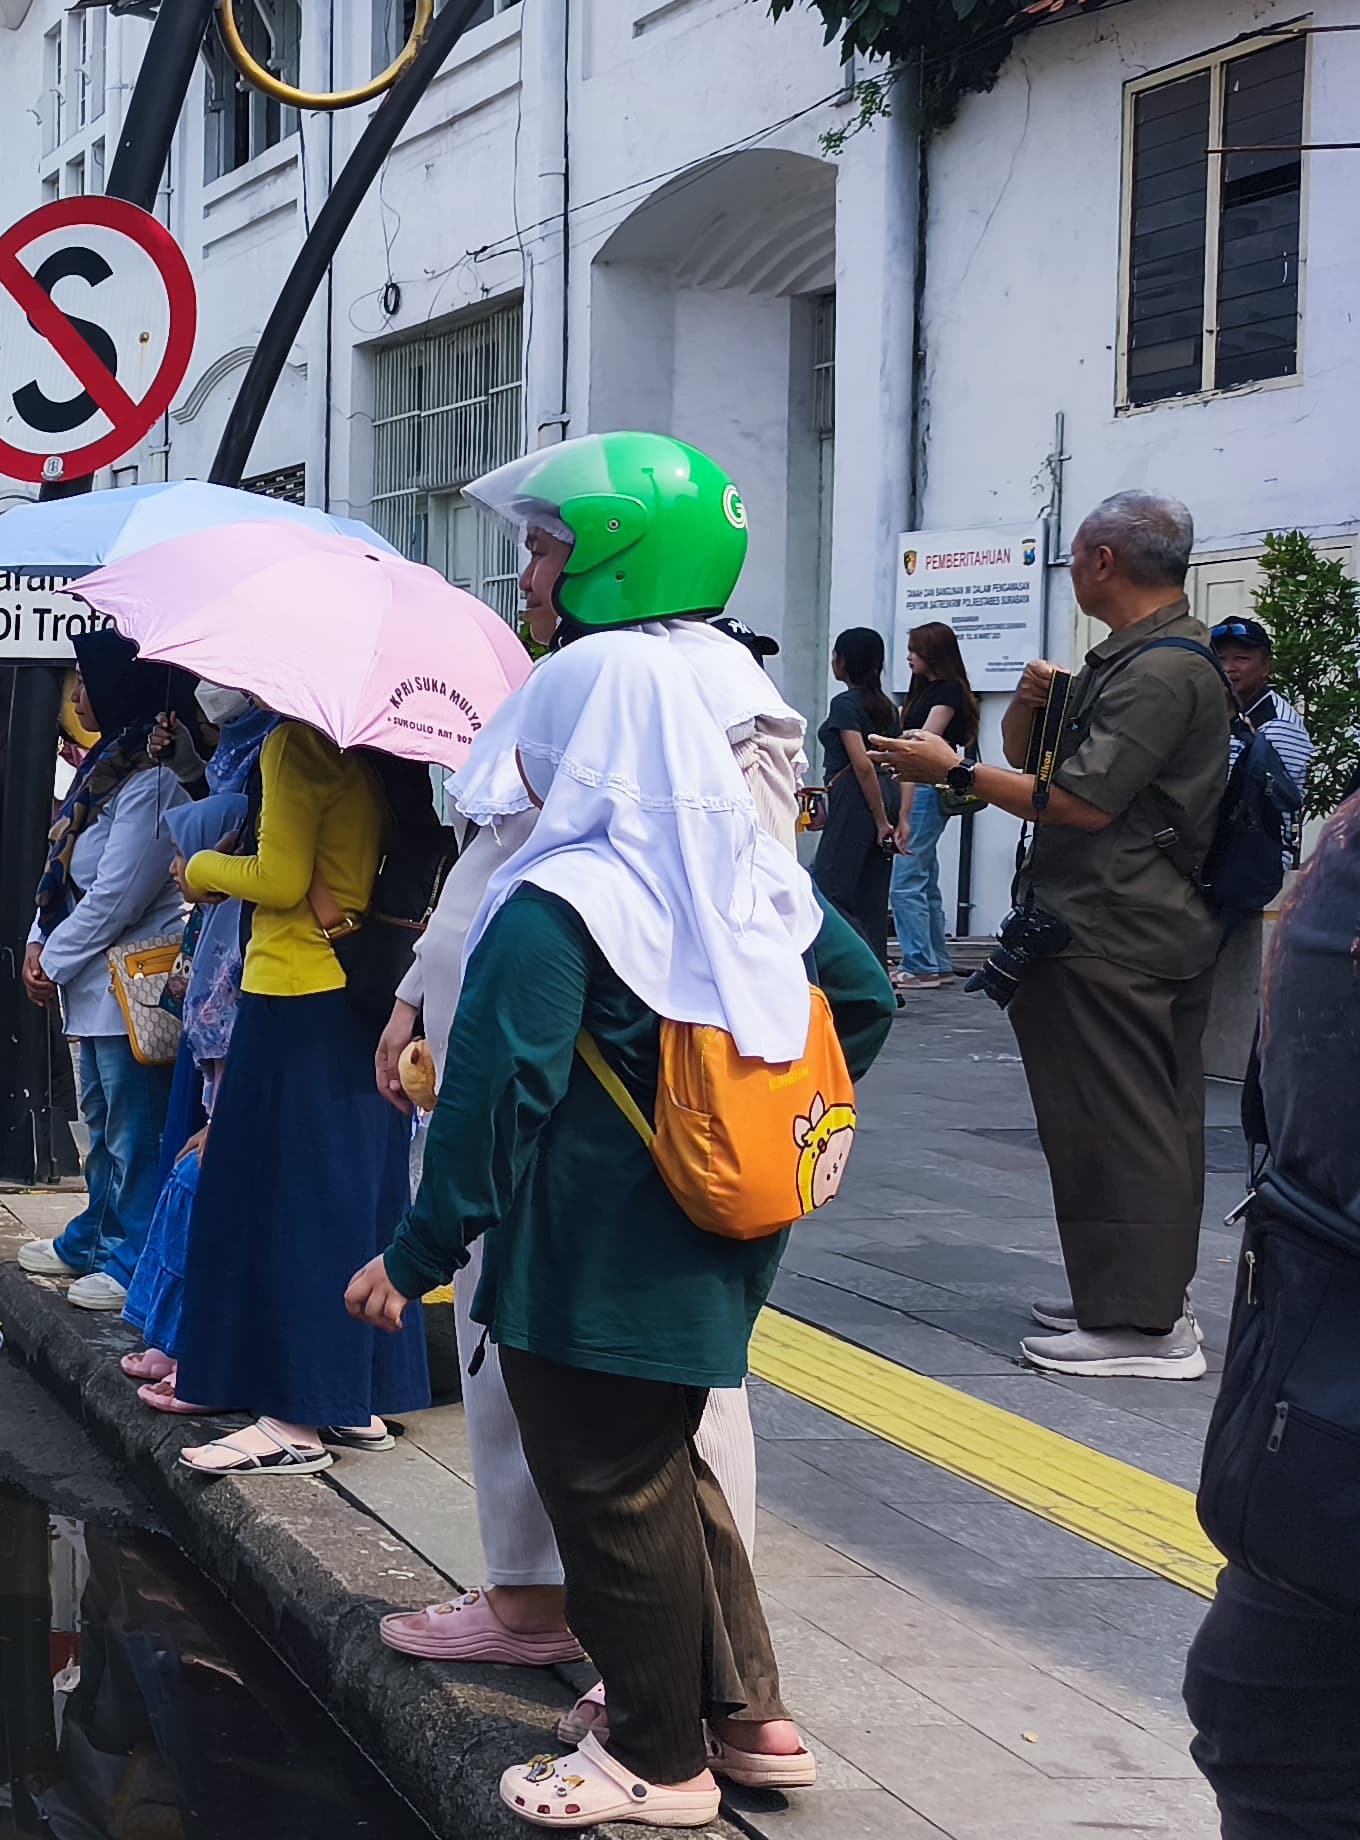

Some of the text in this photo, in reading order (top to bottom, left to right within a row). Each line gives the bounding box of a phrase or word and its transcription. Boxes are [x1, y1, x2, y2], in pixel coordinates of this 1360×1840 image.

[12, 246, 117, 433] S
[925, 548, 1011, 570] PEMBERITAHUAN
[389, 676, 482, 732] KPRI SUKA MULYA
[1040, 750, 1053, 782] Nikon
